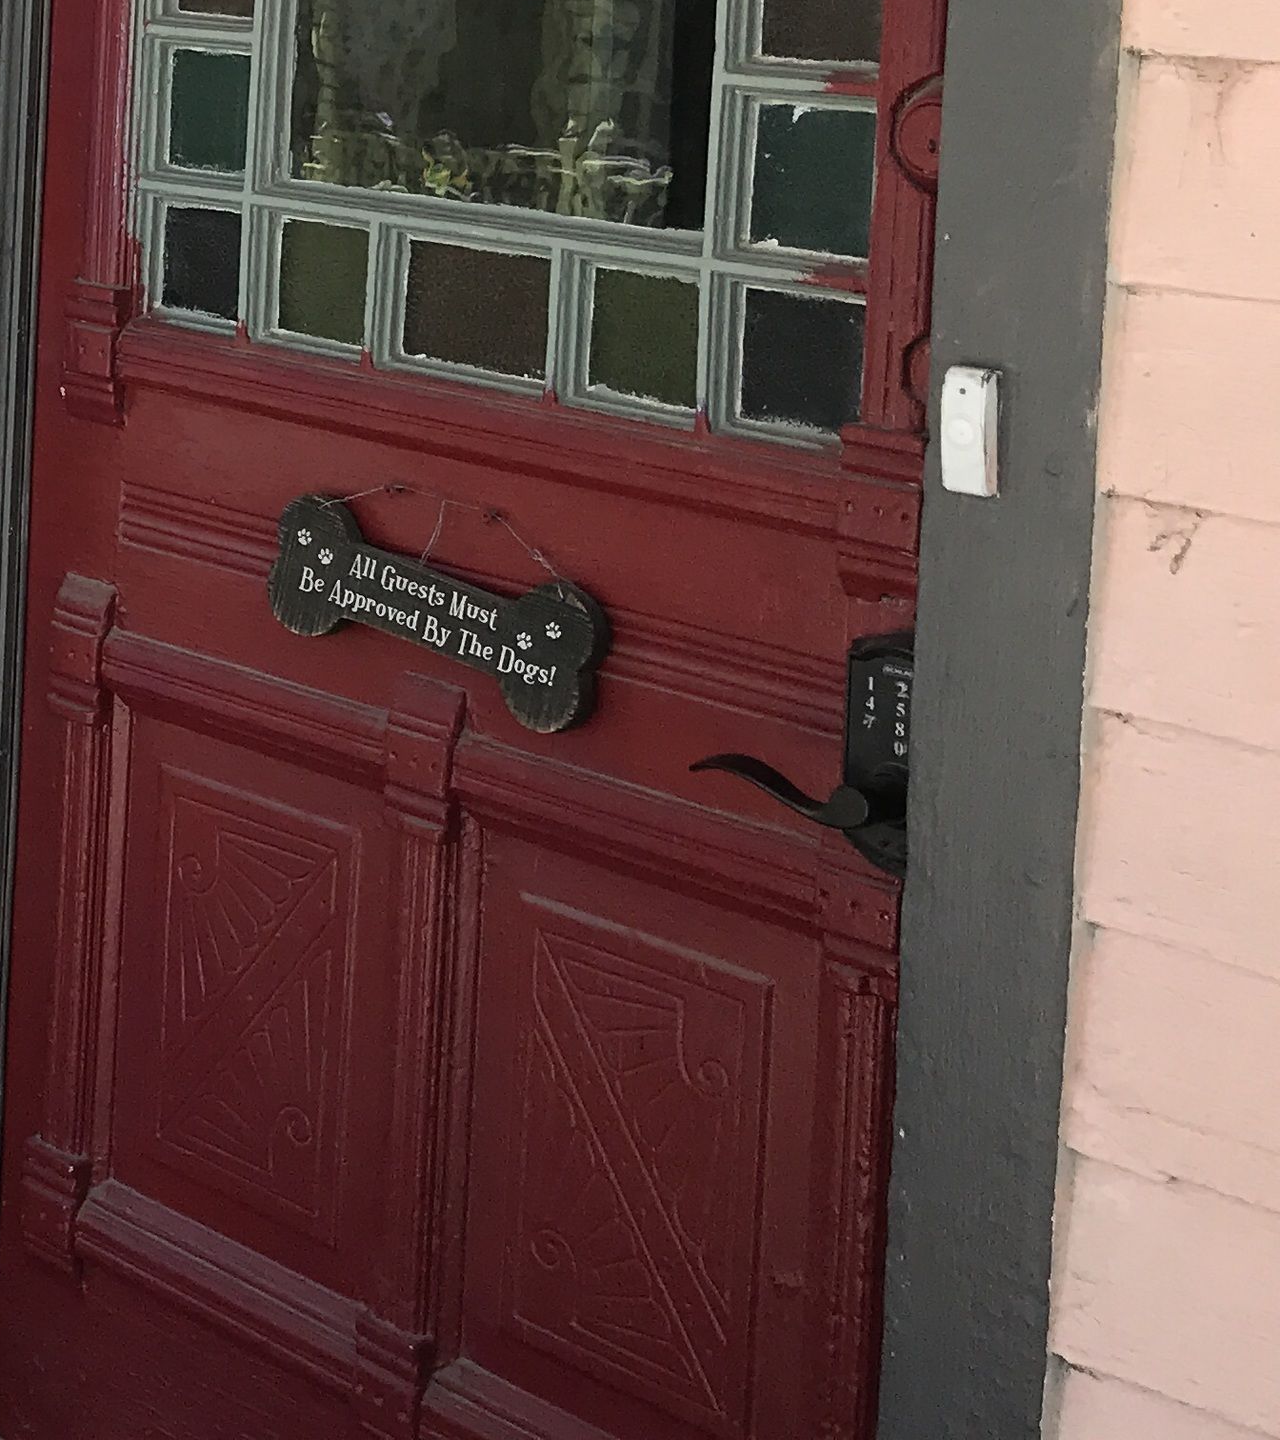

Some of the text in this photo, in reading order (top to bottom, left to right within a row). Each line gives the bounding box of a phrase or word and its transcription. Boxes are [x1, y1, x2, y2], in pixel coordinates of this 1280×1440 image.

[349, 553, 498, 631] All Guests Must
[298, 566, 557, 687] Be Approved By The Dogs!
[895, 680, 909, 698] 2
[865, 695, 906, 717] 4 5
[894, 721, 905, 737] 8
